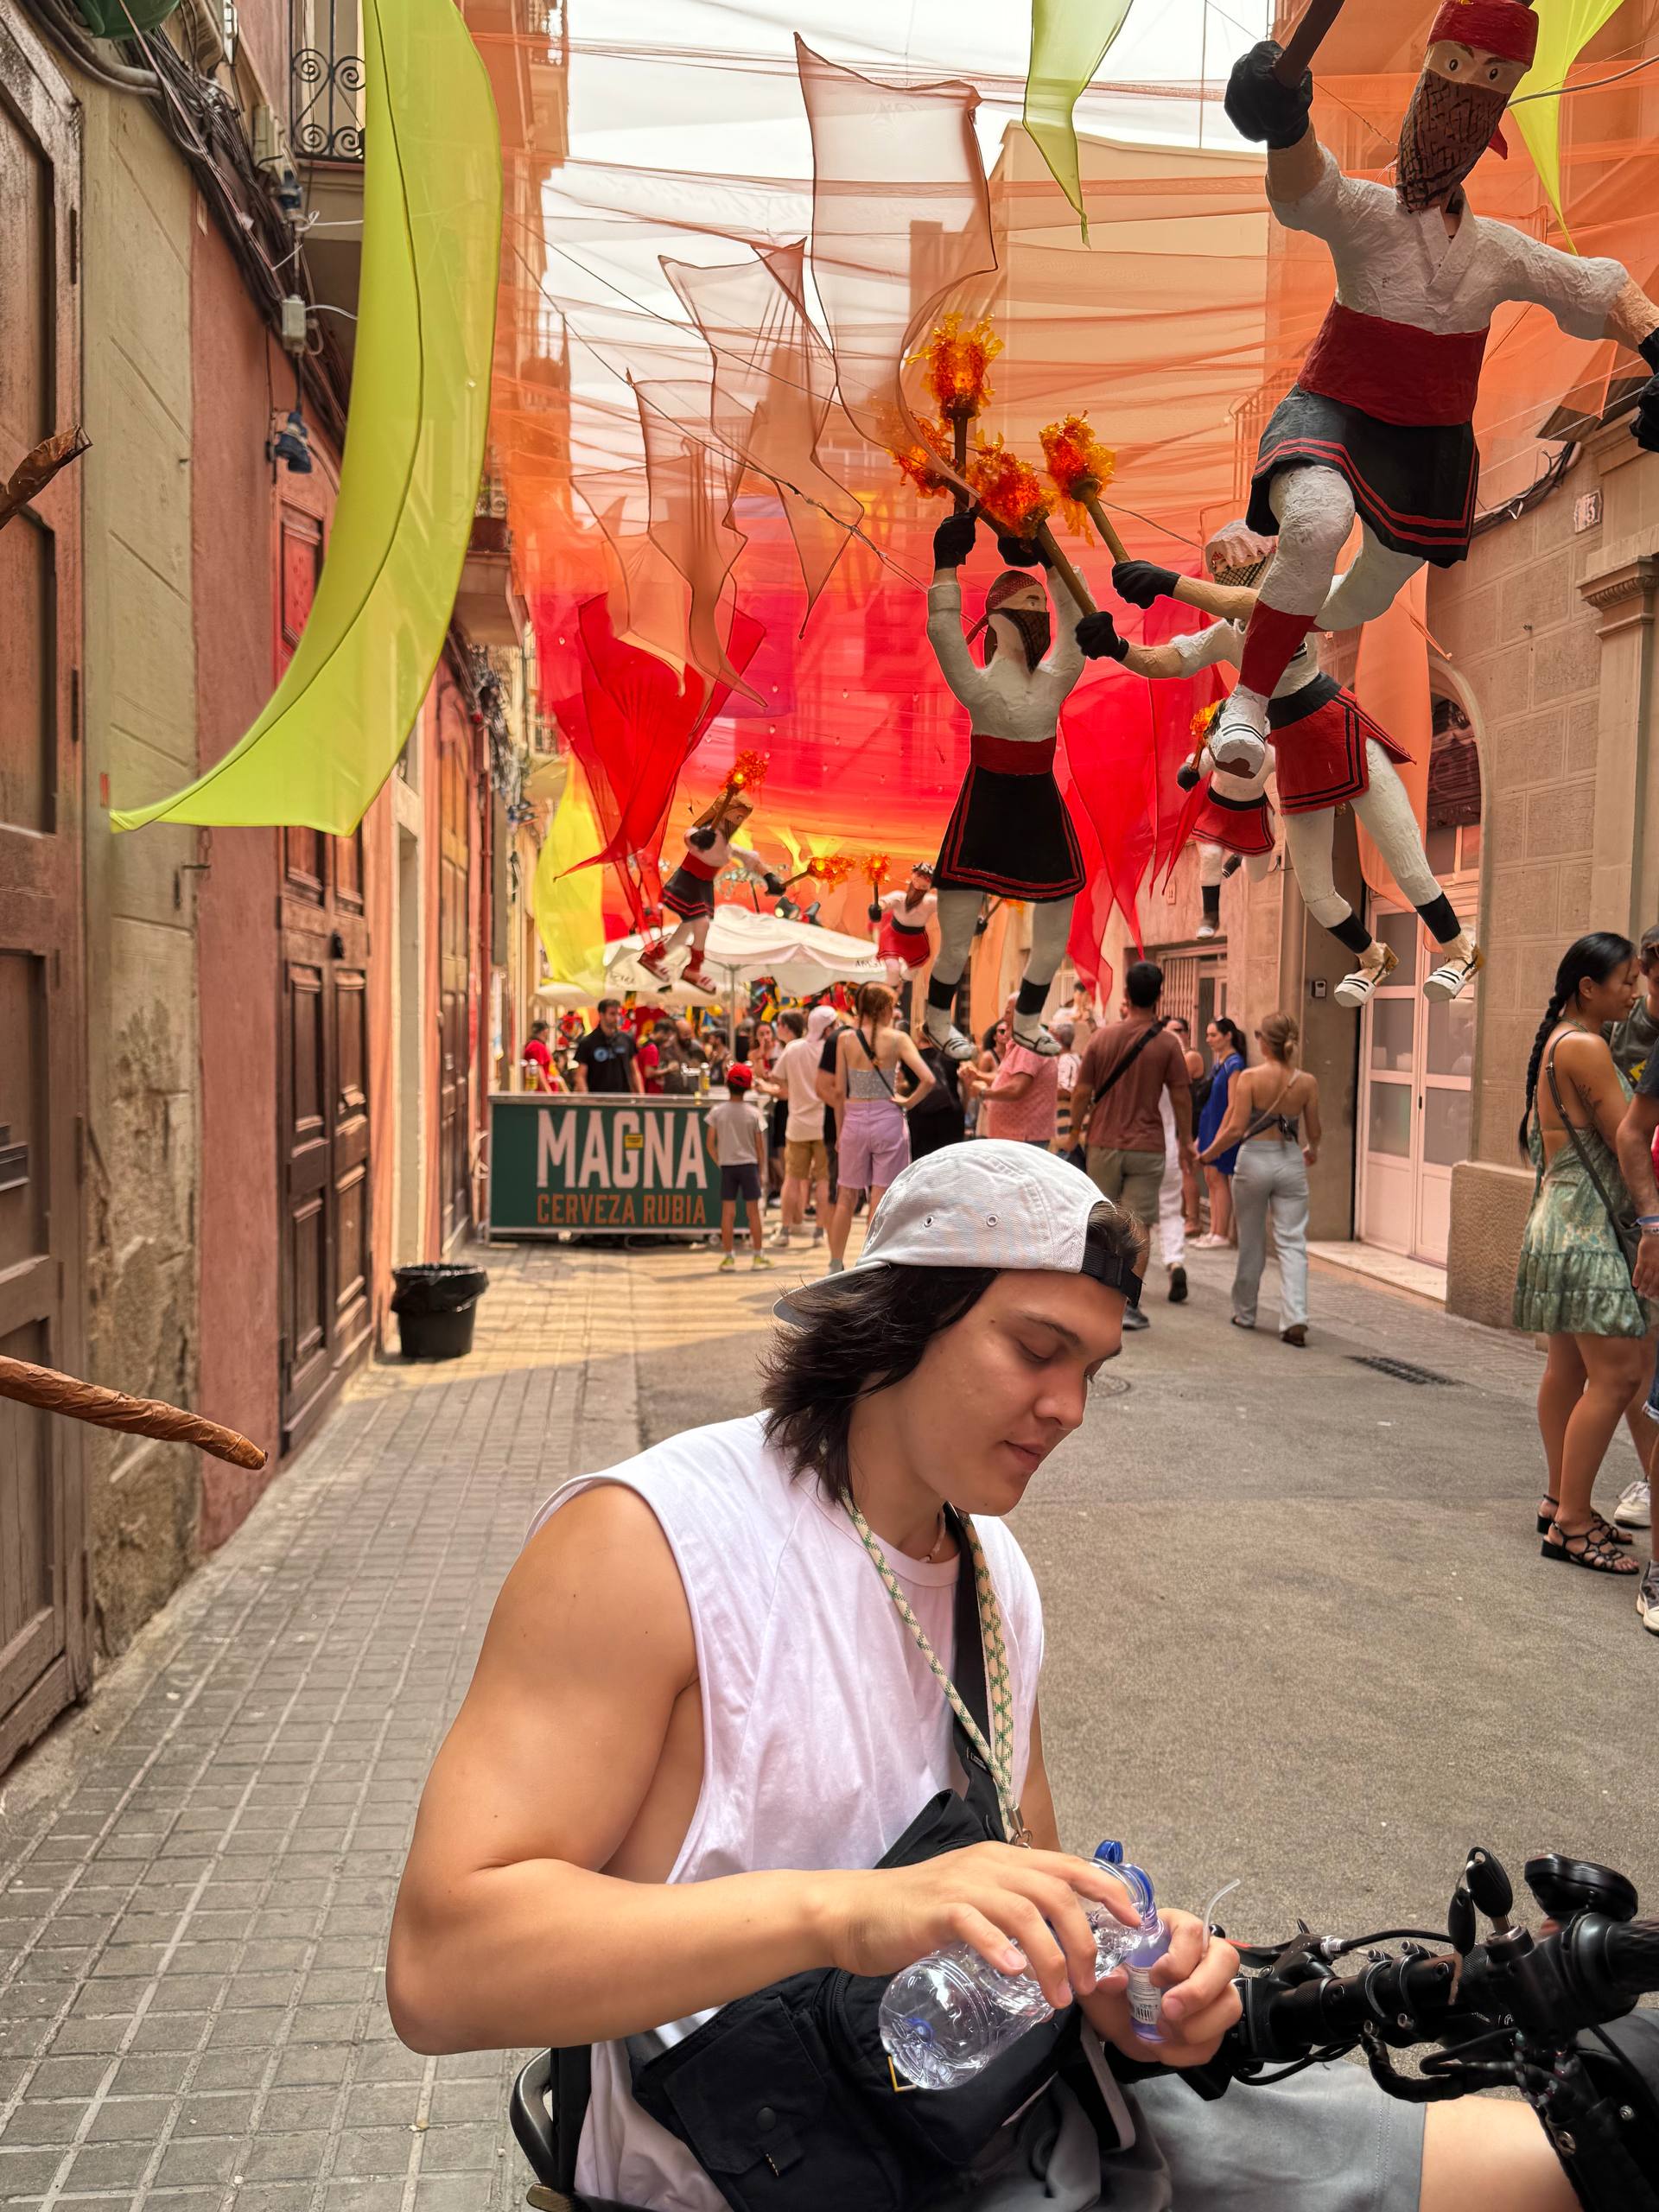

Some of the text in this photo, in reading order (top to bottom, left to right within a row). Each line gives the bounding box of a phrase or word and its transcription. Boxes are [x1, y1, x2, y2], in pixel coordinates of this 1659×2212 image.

[537, 1109, 708, 1189] MAGNA
[537, 1198, 707, 1225] CERVEZA RUBIA
